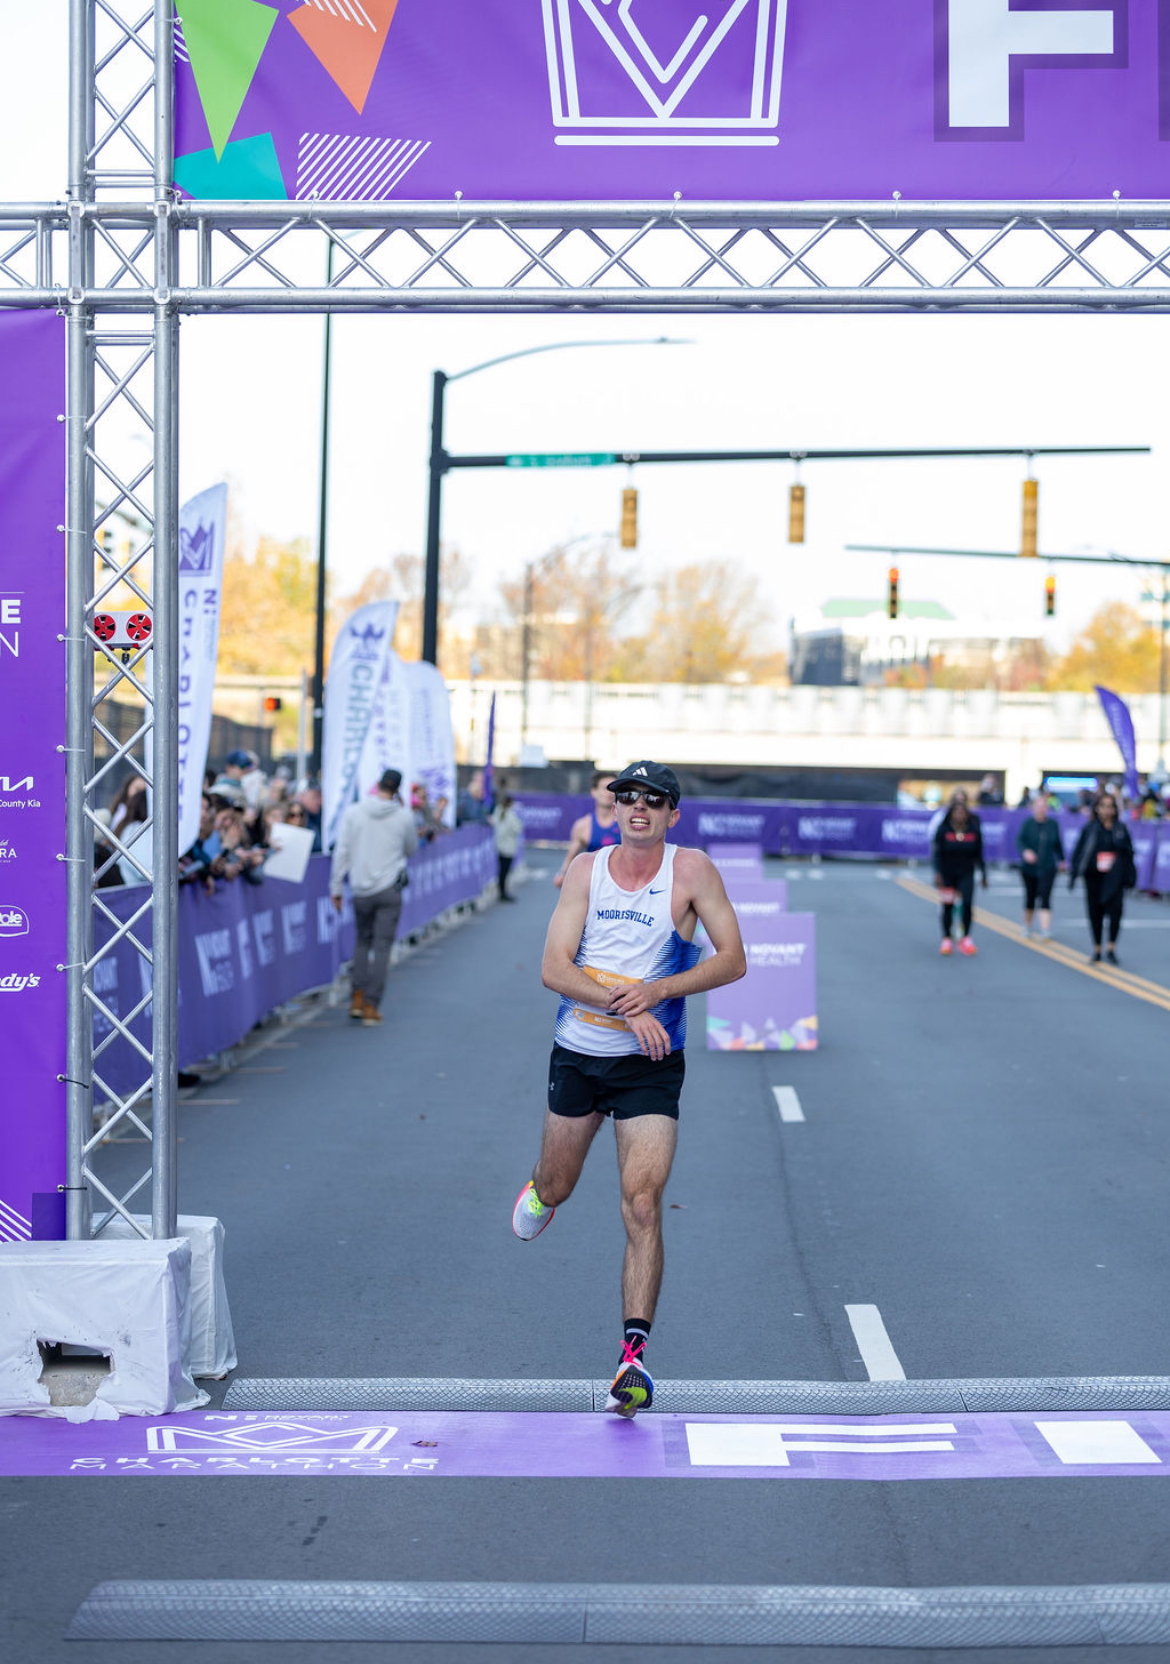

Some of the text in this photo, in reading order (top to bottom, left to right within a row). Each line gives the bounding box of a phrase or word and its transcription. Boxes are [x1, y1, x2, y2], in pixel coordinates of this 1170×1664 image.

[27, 799, 41, 808] Kia
[0, 910, 23, 924] ole
[597, 909, 655, 927] MOORESVILLE
[73, 1457, 440, 1465] CHARLOTTE
[70, 1463, 435, 1471] MARATHON
